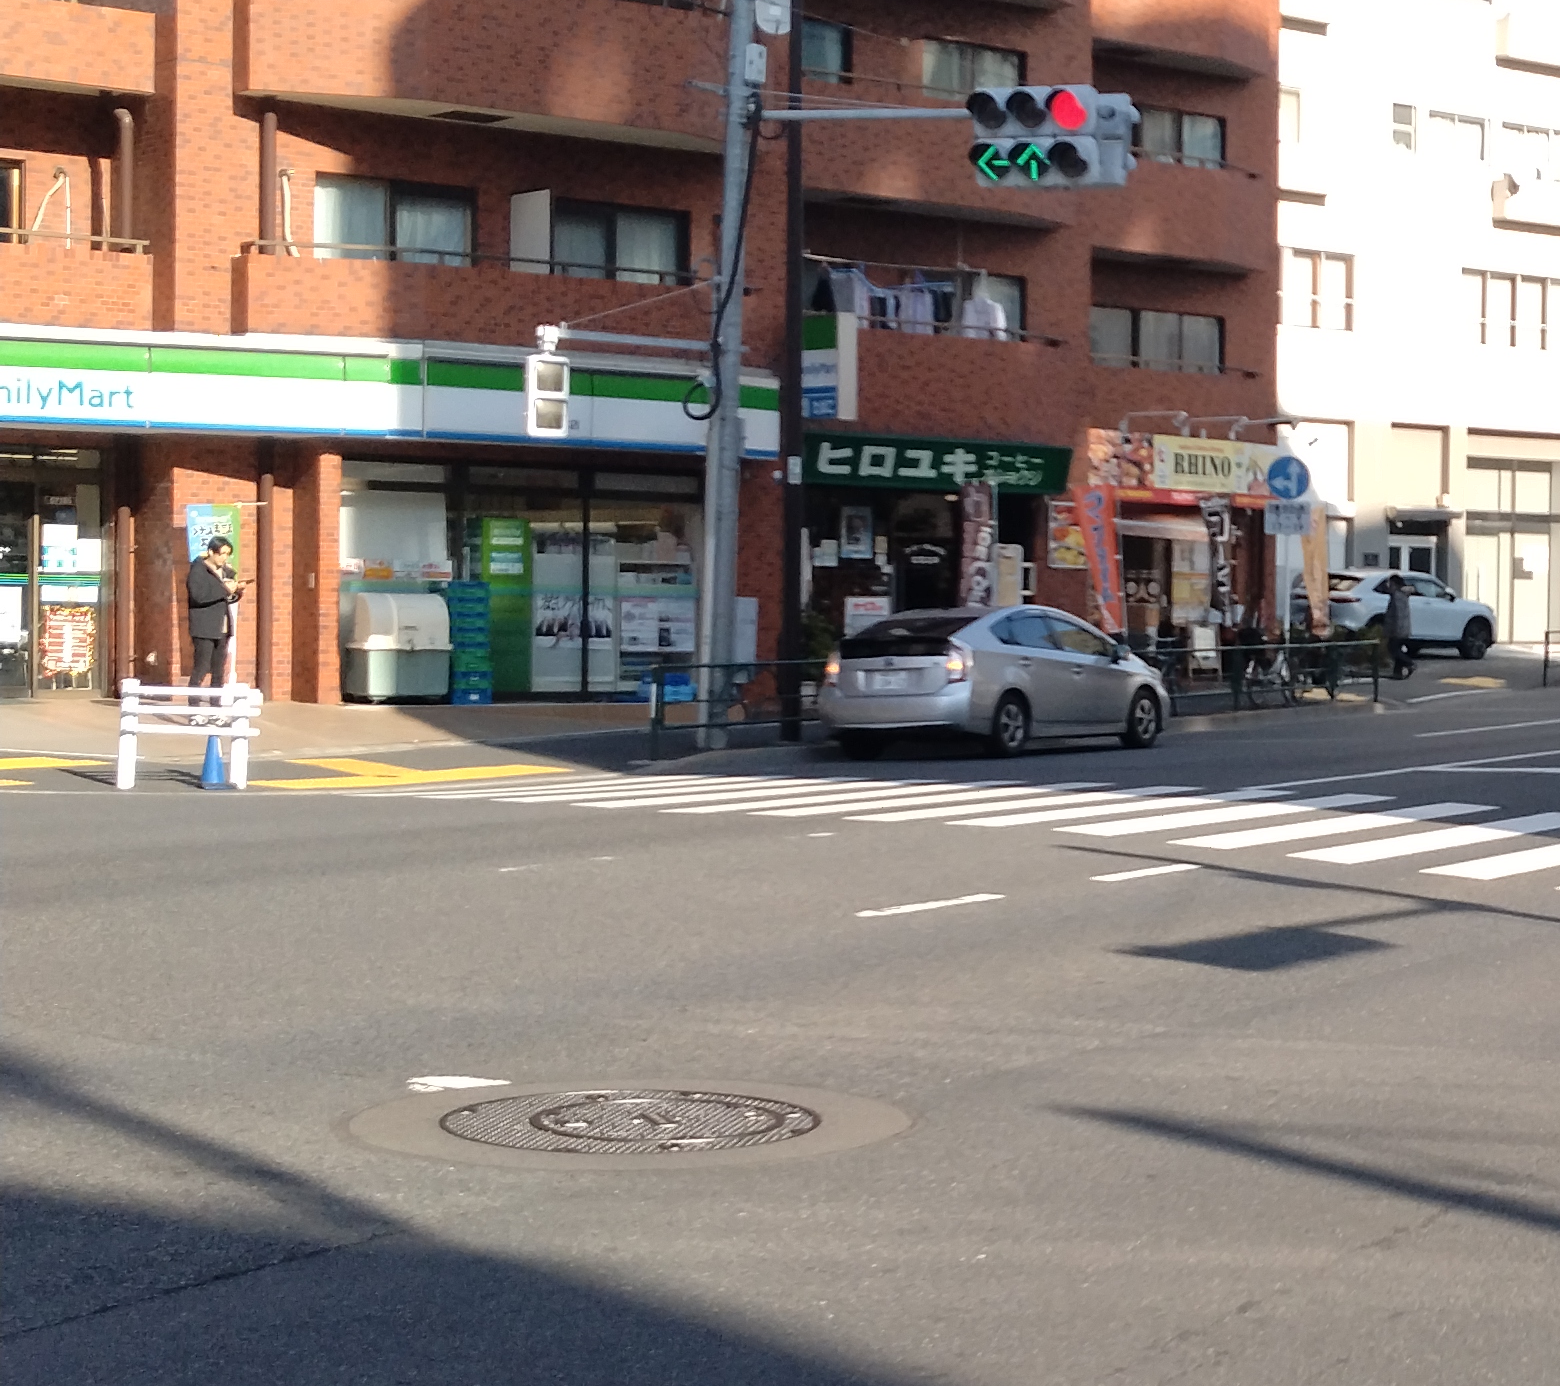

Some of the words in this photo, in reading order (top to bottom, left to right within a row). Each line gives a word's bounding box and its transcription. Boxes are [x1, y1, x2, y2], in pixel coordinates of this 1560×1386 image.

[816, 441, 979, 484] ヒロユキ
[1173, 451, 1233, 478] RHINO
